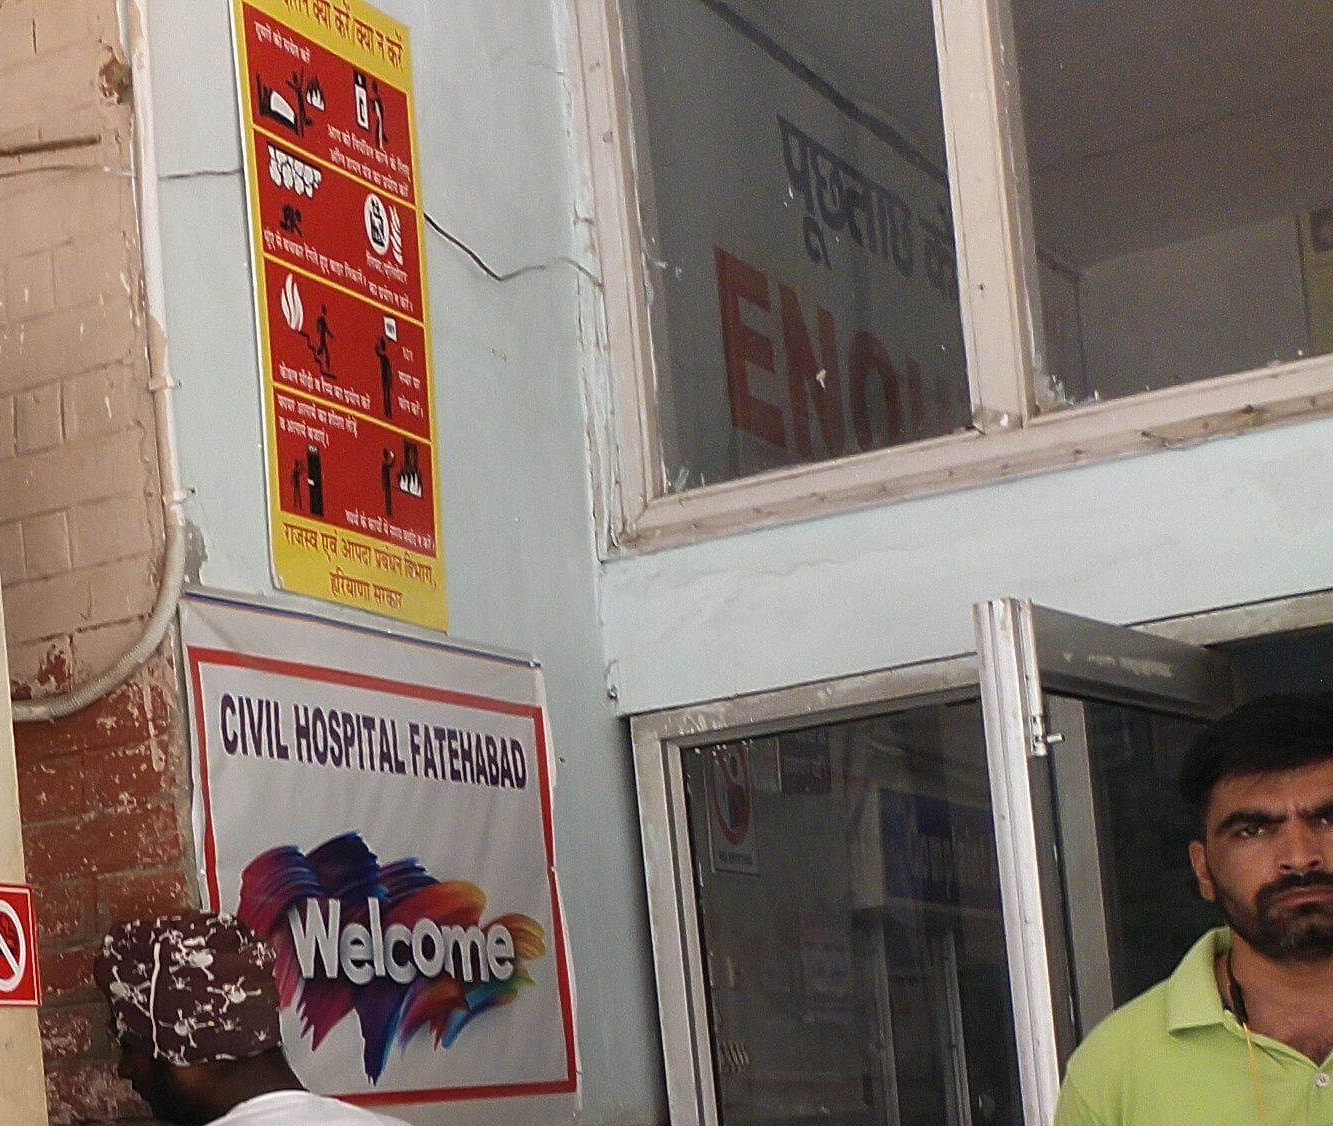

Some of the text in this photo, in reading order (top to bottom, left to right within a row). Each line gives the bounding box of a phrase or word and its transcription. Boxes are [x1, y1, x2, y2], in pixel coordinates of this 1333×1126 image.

[283, 522, 318, 550] राजस्व
[341, 537, 372, 567] आपदा
[329, 565, 404, 609] हरियाणा सरकार
[220, 692, 528, 790] CIVIL HOSPITAL FATEHABAD
[287, 896, 517, 985] Welcome
